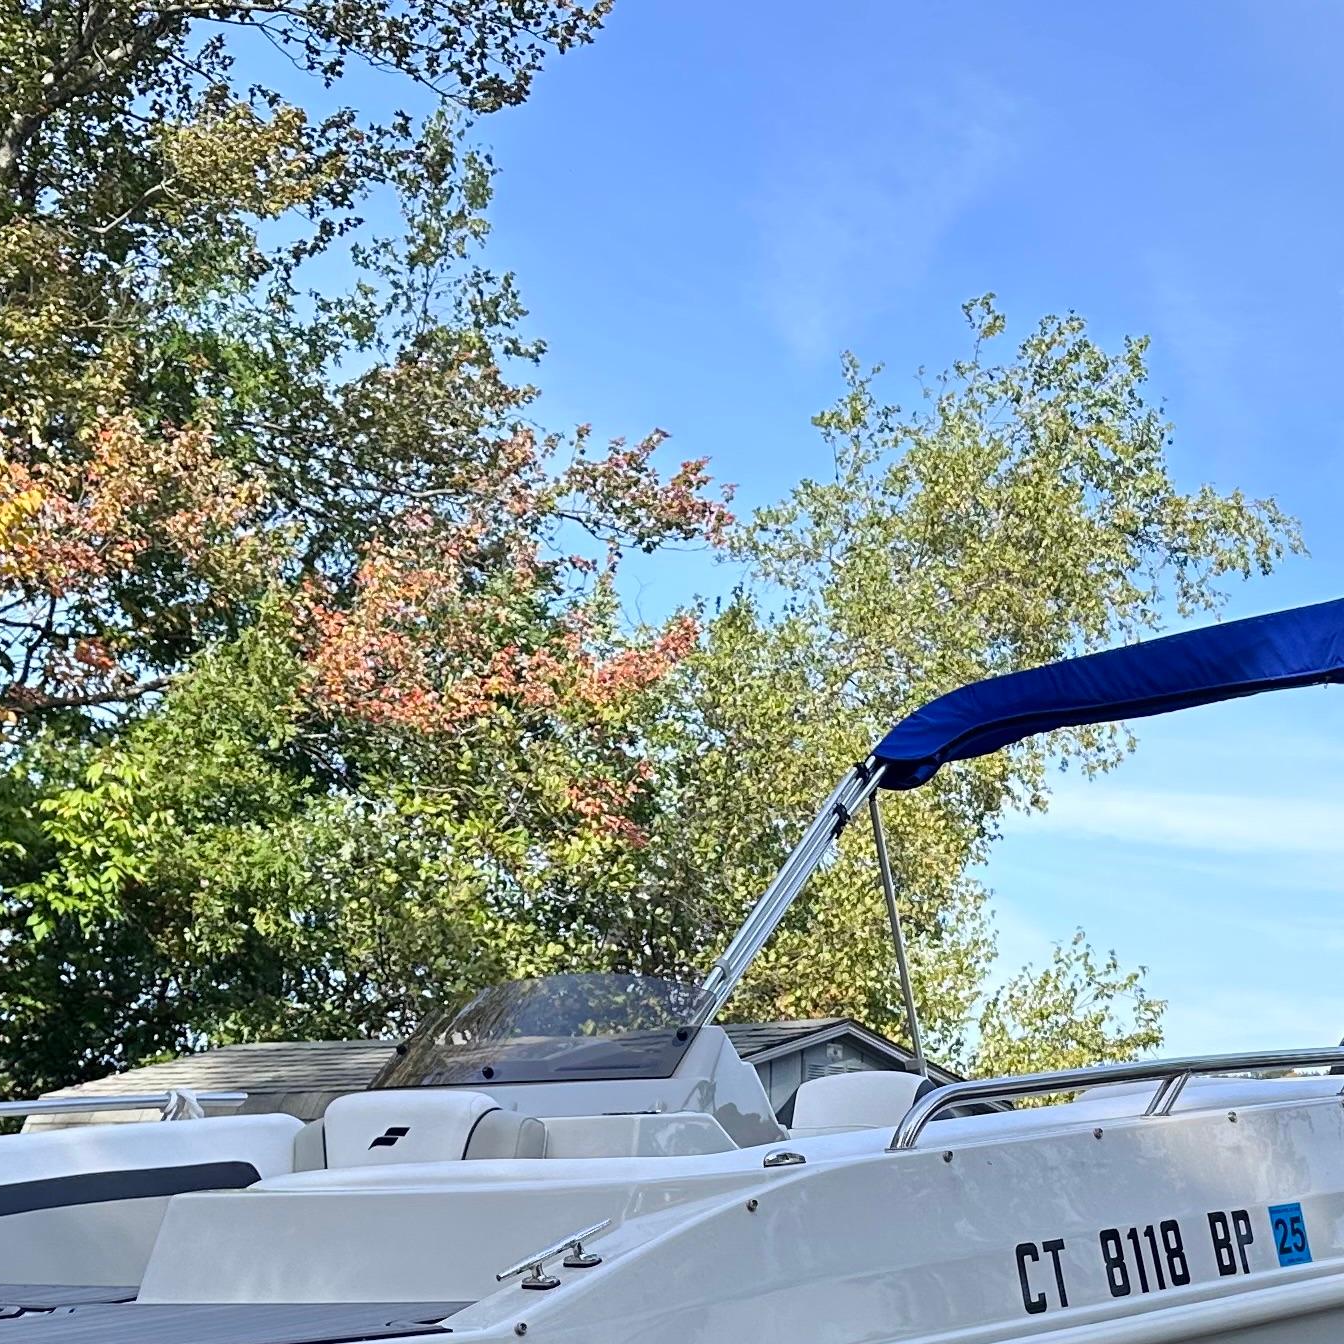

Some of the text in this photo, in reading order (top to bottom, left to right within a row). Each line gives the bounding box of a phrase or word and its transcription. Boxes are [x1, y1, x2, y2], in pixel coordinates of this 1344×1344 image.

[1015, 1209, 1254, 1315] CT 8118 BP
[1275, 1215, 1306, 1255] 25
